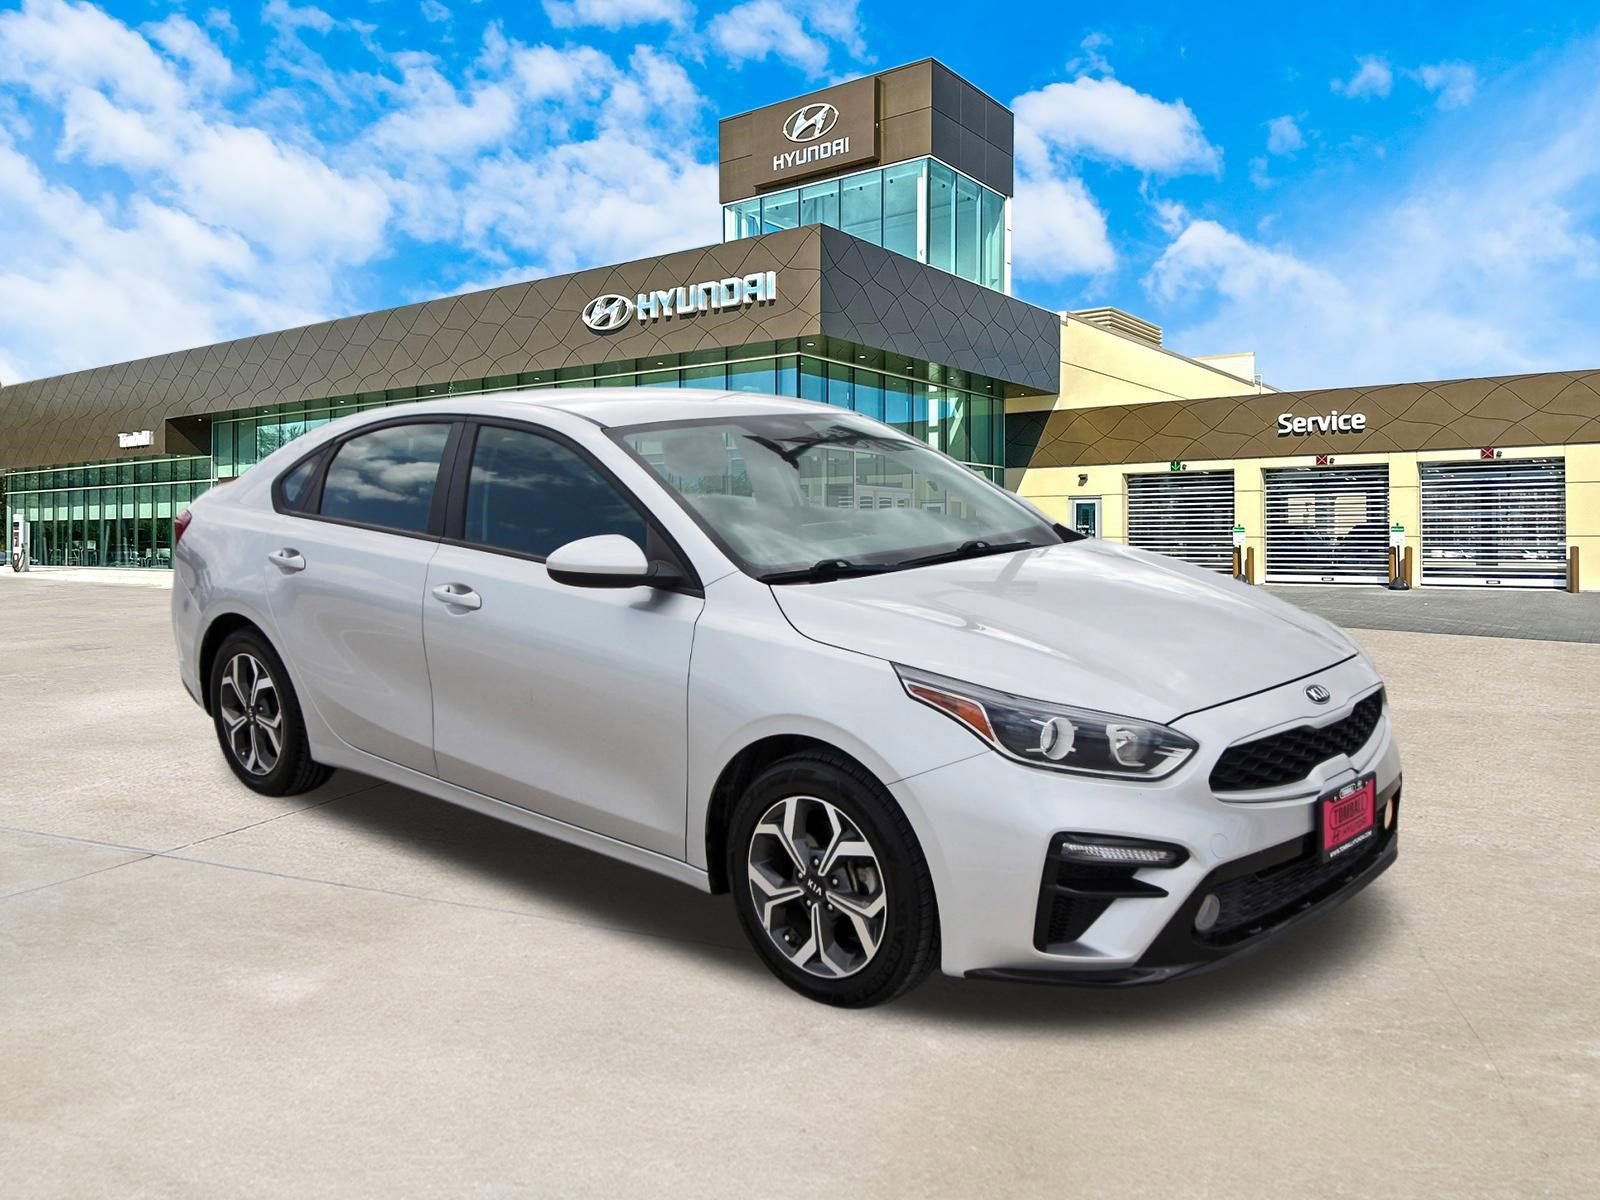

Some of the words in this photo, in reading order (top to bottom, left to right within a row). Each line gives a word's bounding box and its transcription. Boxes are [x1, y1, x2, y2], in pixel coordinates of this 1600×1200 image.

[772, 136, 850, 171] HYUNDAI
[636, 270, 777, 321] HYUNDAI
[1277, 410, 1367, 435] Service
[807, 879, 822, 896] KIA
